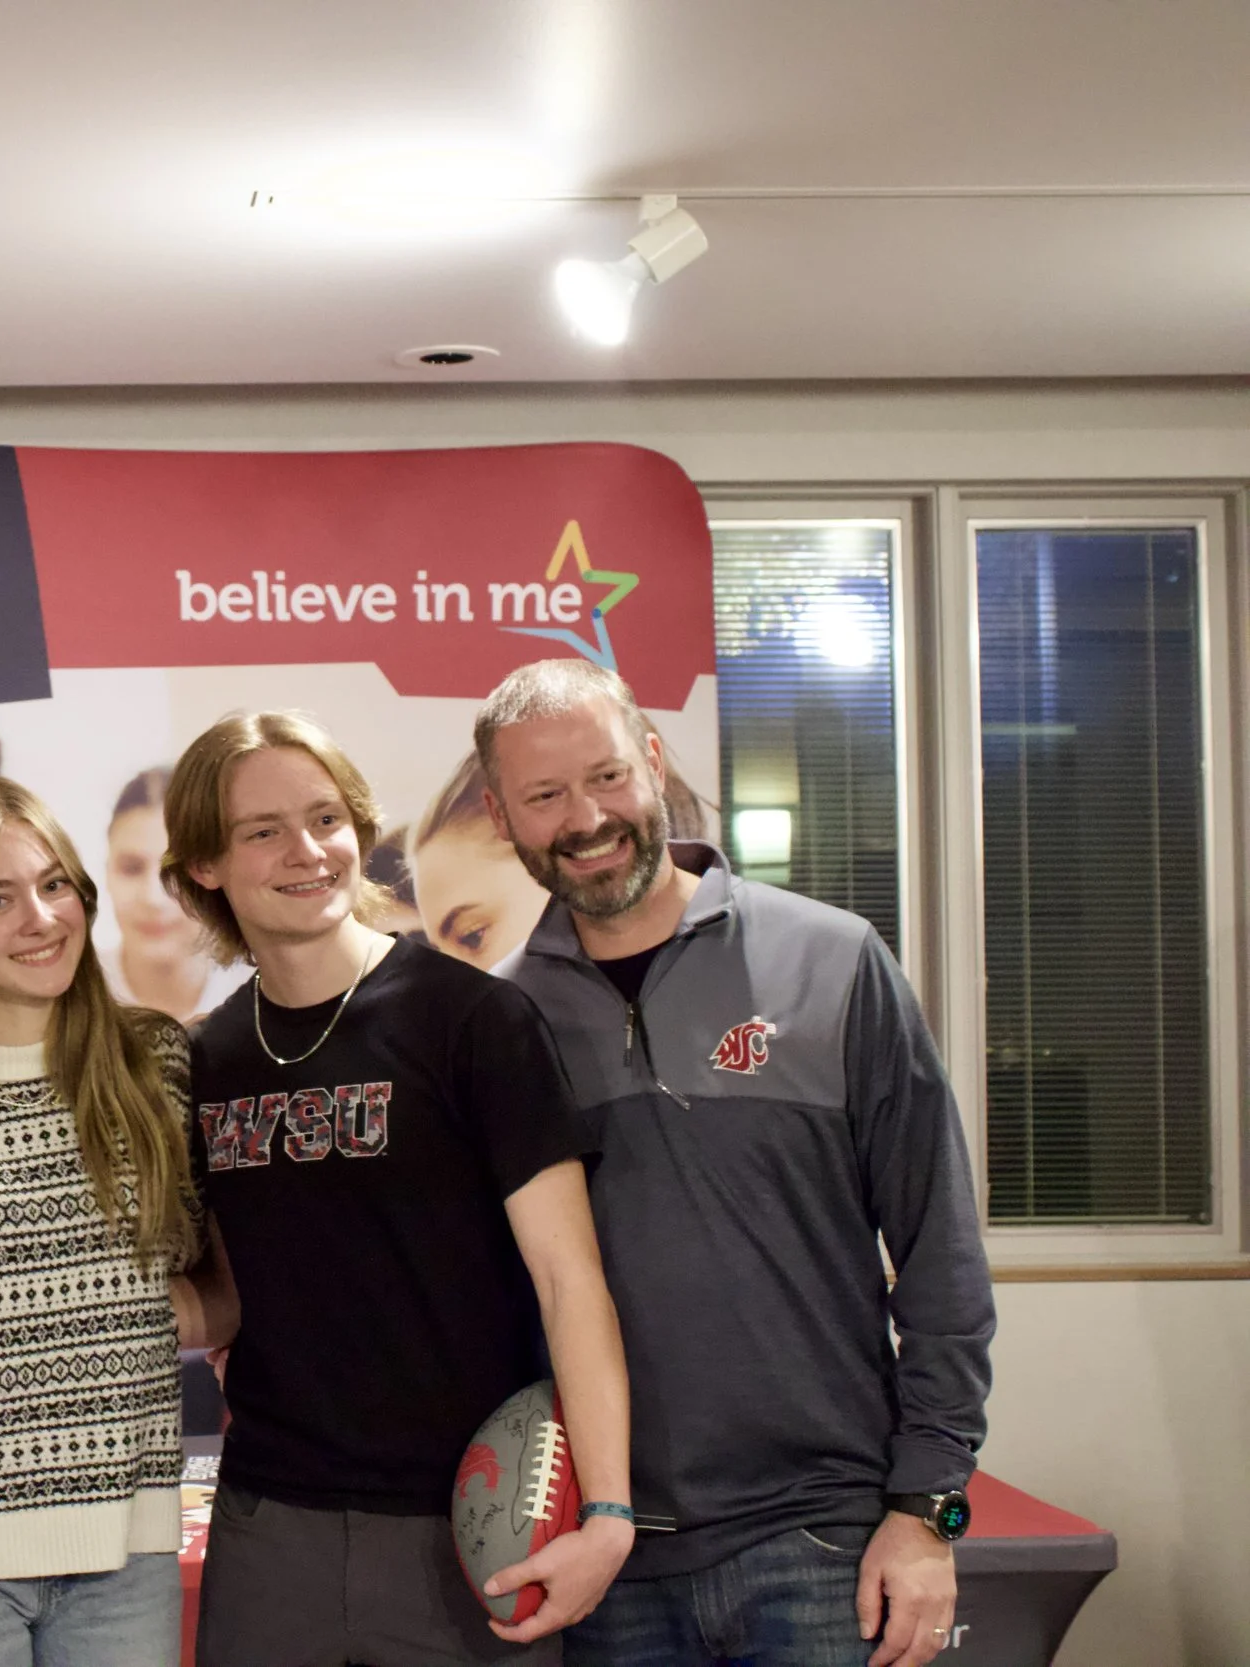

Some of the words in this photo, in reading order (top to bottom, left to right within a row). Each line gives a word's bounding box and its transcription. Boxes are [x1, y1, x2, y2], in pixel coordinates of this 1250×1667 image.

[175, 570, 397, 624] believe
[412, 570, 474, 622] in
[488, 582, 582, 623] me
[200, 1081, 392, 1172] WSU
